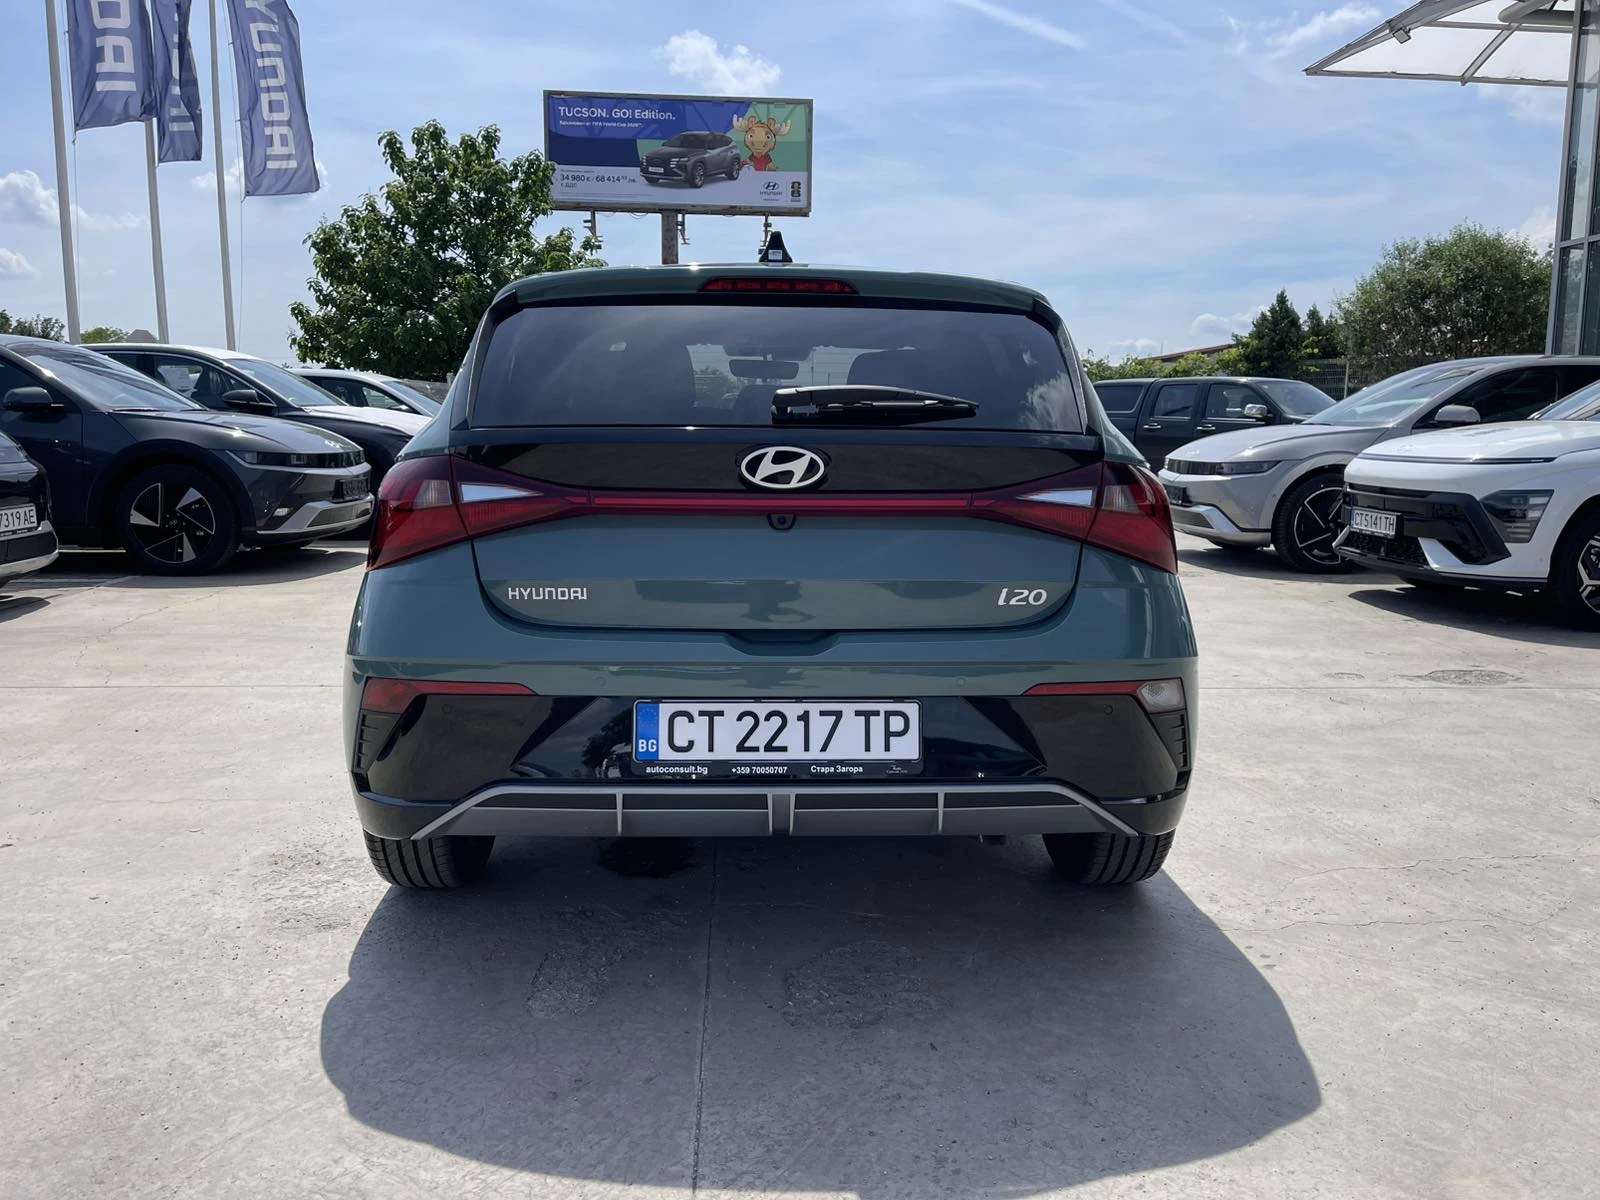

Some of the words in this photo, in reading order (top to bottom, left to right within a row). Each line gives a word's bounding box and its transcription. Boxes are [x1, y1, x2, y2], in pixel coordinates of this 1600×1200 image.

[558, 106, 609, 118] TUCSON.
[612, 108, 632, 119] GO!
[634, 109, 676, 121] Edition.
[24, 508, 35, 525] AE
[508, 587, 588, 600] HYUNDAI
[667, 710, 725, 753] CT
[735, 710, 843, 753] 2217
[854, 710, 911, 753] TP
[638, 739, 657, 752] BG
[645, 765, 709, 775] autoconsult.bg
[731, 766, 750, 775] +359
[752, 766, 788, 775] 70050707
[810, 765, 835, 775] Стара
[836, 765, 864, 775] Загора
